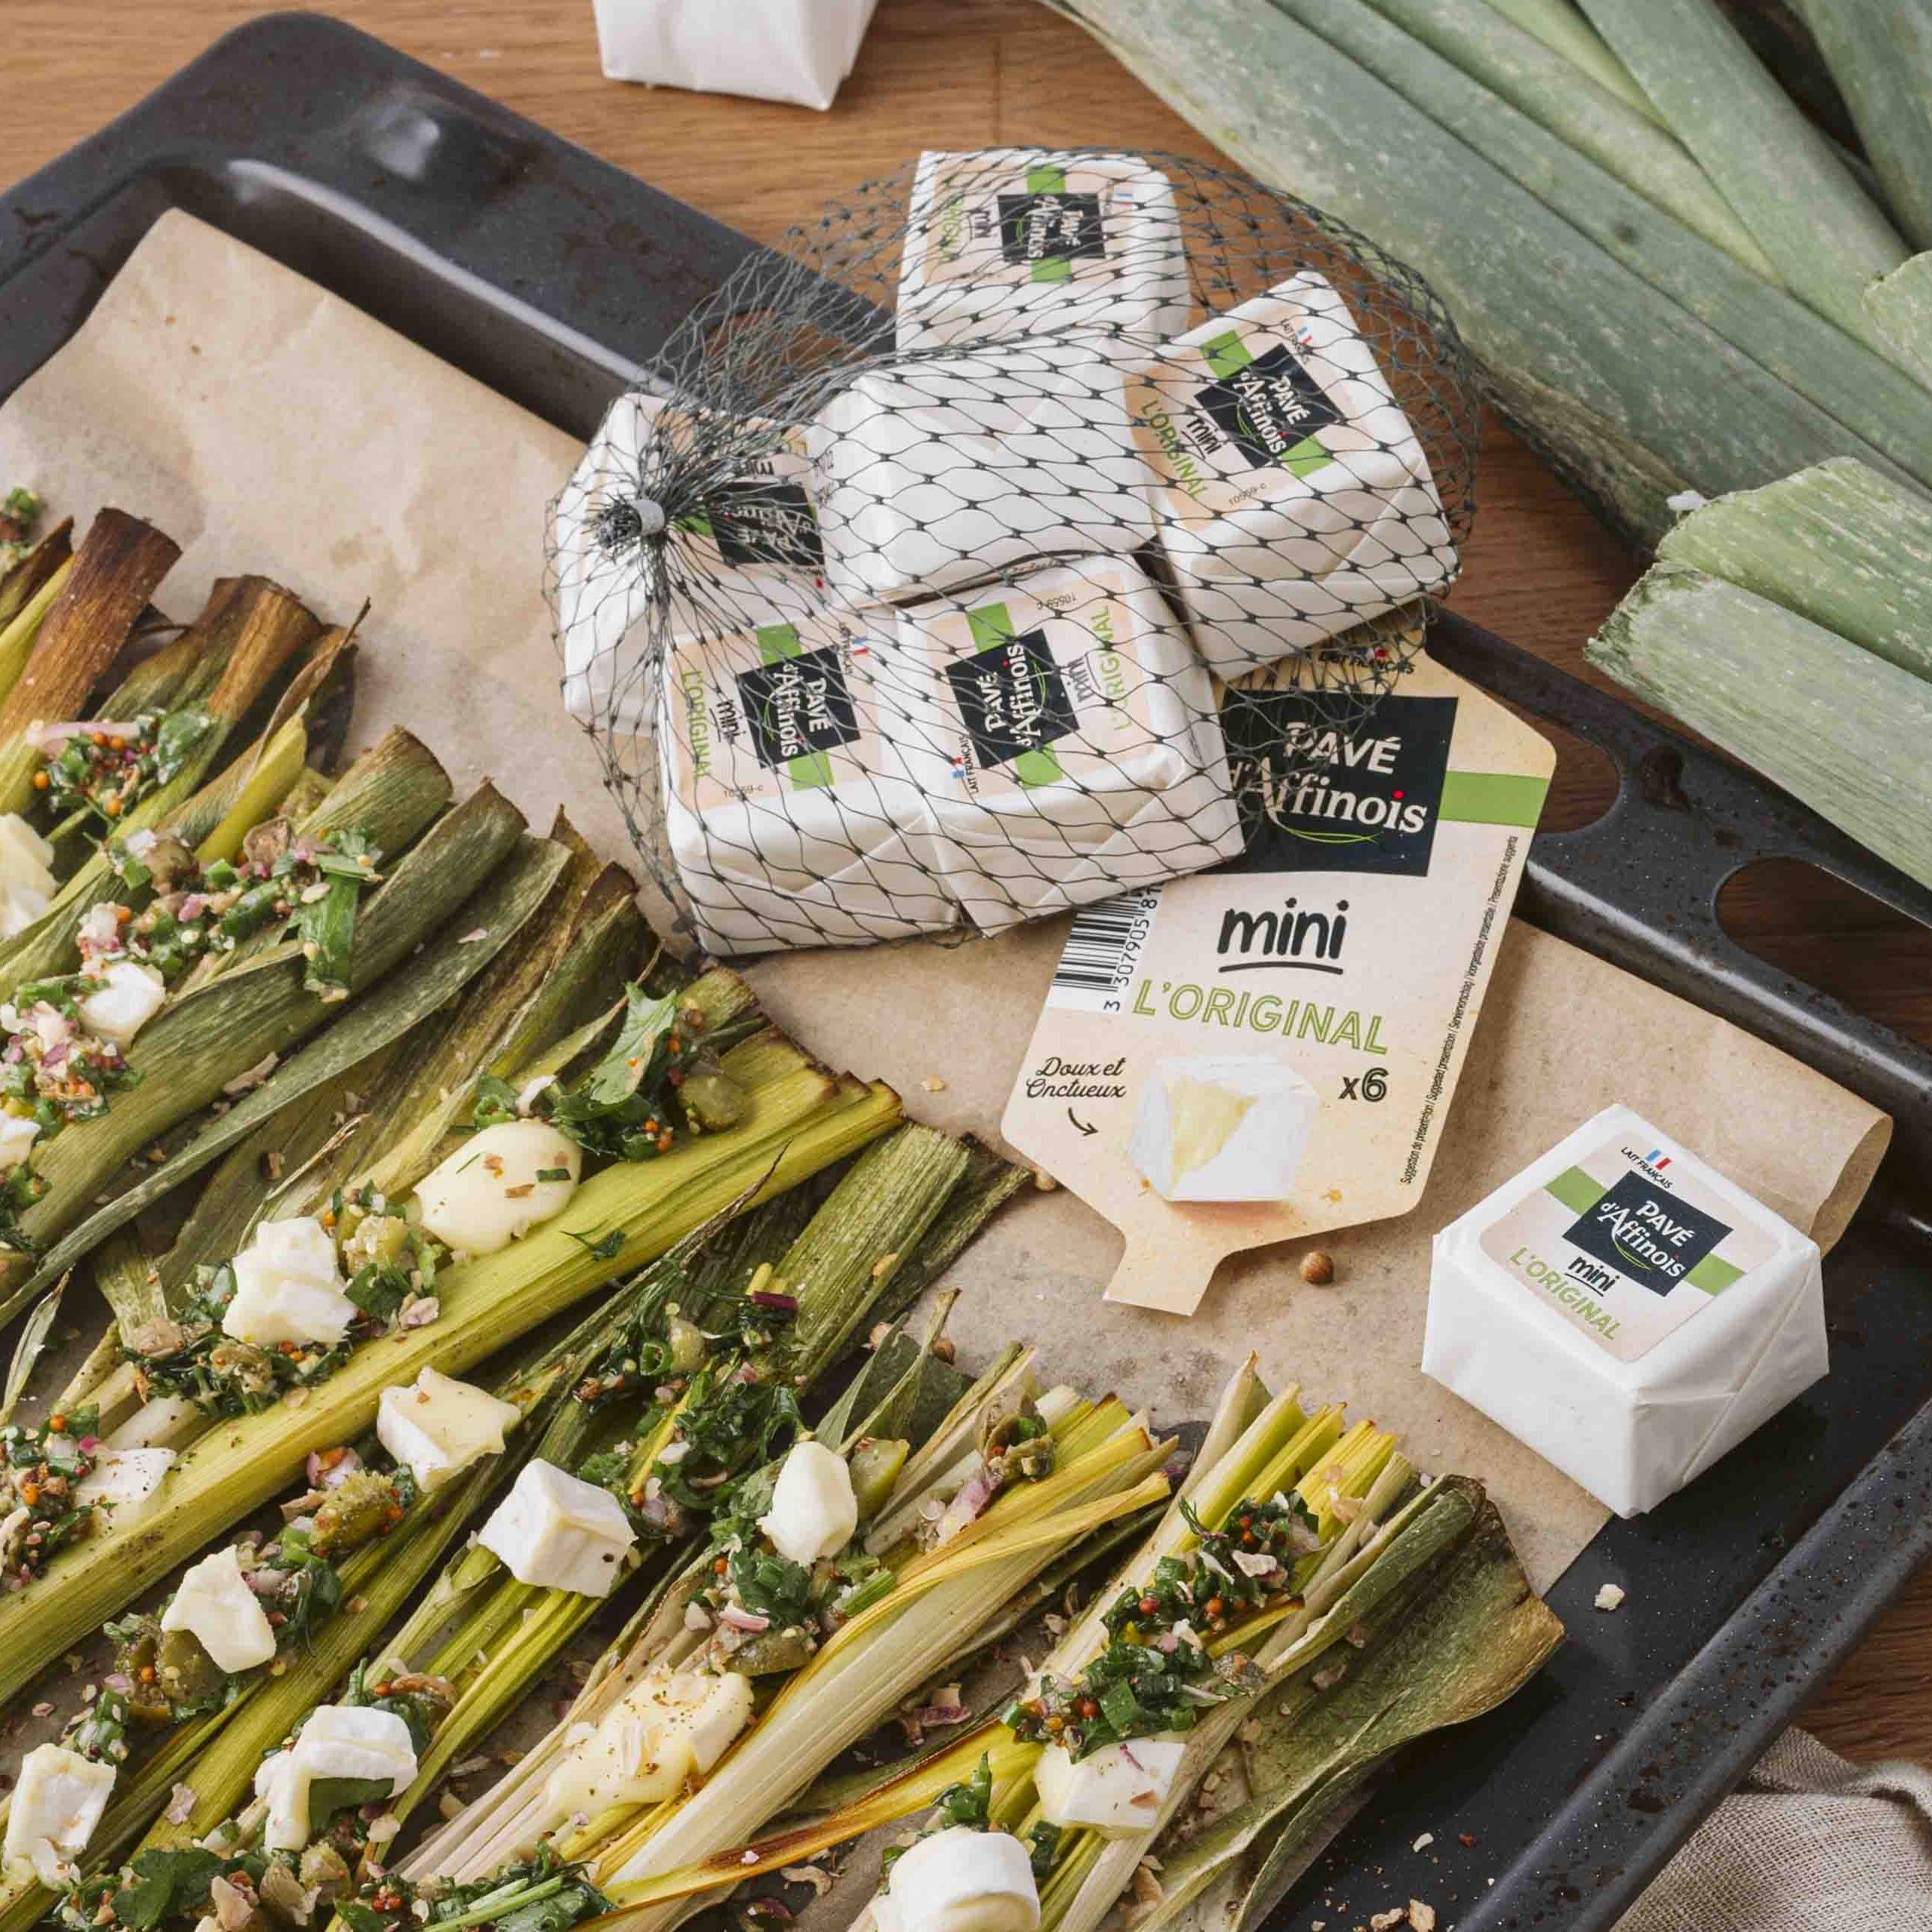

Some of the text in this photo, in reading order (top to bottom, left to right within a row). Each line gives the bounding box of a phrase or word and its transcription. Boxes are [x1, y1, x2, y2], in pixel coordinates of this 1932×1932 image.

[1232, 371, 1288, 454] d'Affinois
[1269, 374, 1311, 426] PAVÉ
[1186, 415, 1228, 455] mini
[715, 699, 747, 739] mini
[768, 663, 805, 758] d'Affinois
[808, 677, 831, 733] PAVÉ
[976, 672, 1004, 733] PAVÉ
[1002, 643, 1042, 747] d'Affinois
[1282, 721, 1402, 775] PAVÉ
[967, 777, 980, 794] LAIT
[1217, 897, 1349, 960] mini
[1131, 979, 1389, 1055] L'ORIGINAL
[1026, 1078, 1127, 1098] Onctueux
[1035, 1056, 1127, 1076] Doux et
[1338, 1066, 1389, 1103] x6
[1400, 1149, 1420, 1183] Suggestion
[1412, 1141, 1422, 1150] de
[1621, 1146, 1674, 1190] LAIT FRANÇAIS
[1597, 1201, 1687, 1278] d'Affinois
[1635, 1199, 1696, 1247] PAVÉ
[1508, 1247, 1623, 1342] L'ORIGINAL
[1567, 1256, 1621, 1292] mini
